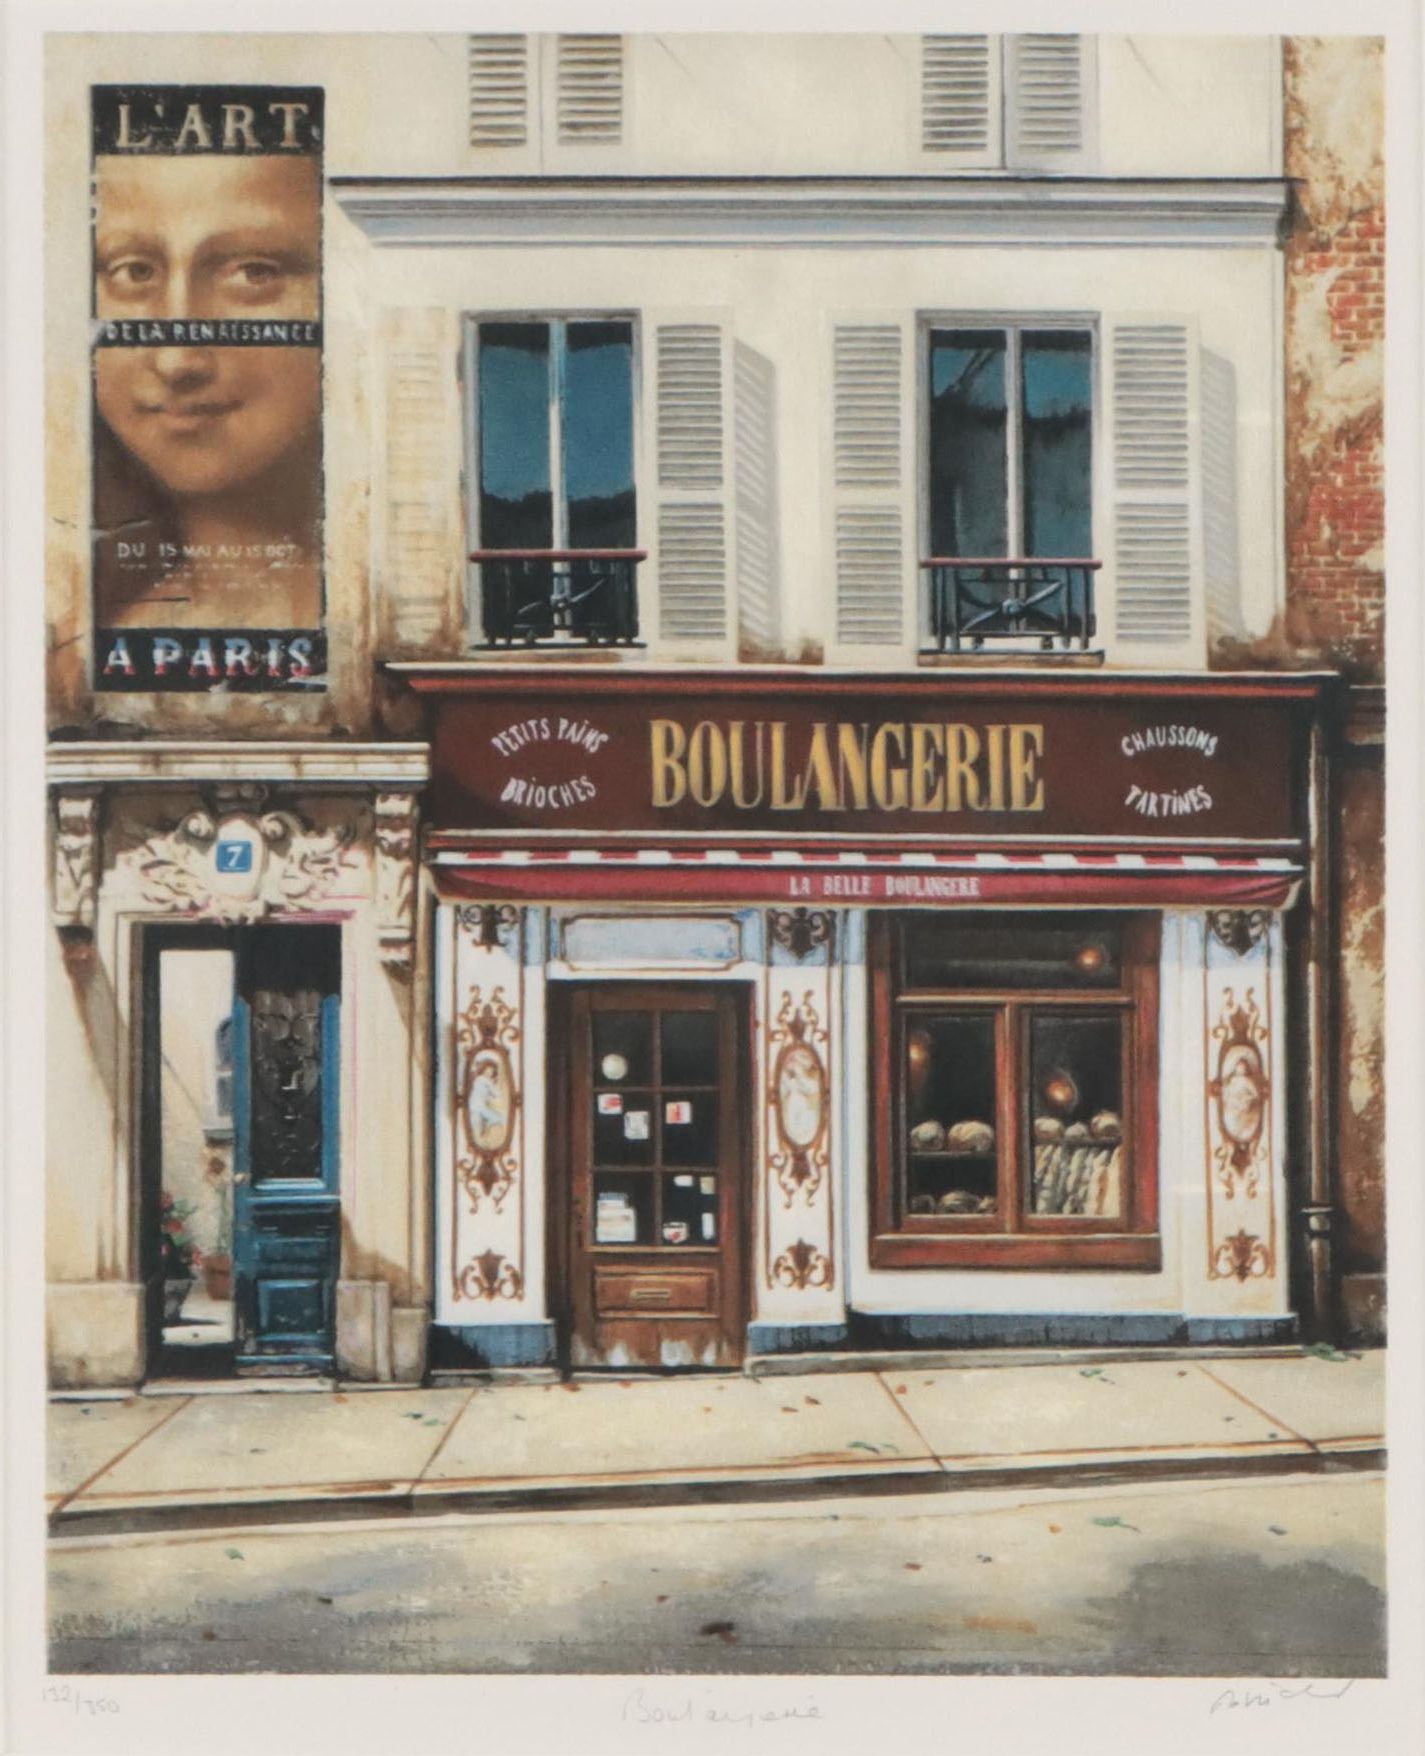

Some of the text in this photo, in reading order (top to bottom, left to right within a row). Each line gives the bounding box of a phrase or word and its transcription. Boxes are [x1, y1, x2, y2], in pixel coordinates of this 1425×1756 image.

[115, 103, 309, 150] L'ART
[173, 322, 316, 341] RENAISSANCE
[117, 542, 145, 558] DU
[158, 543, 177, 558] 15
[103, 637, 313, 677] A PARIS
[491, 718, 551, 757] PETITS
[1121, 724, 1219, 757] CHAUSSONS
[649, 718, 1045, 813] BOULANGERIE
[226, 845, 243, 867] 7
[789, 876, 811, 896] LA
[822, 876, 872, 896] BELLE
